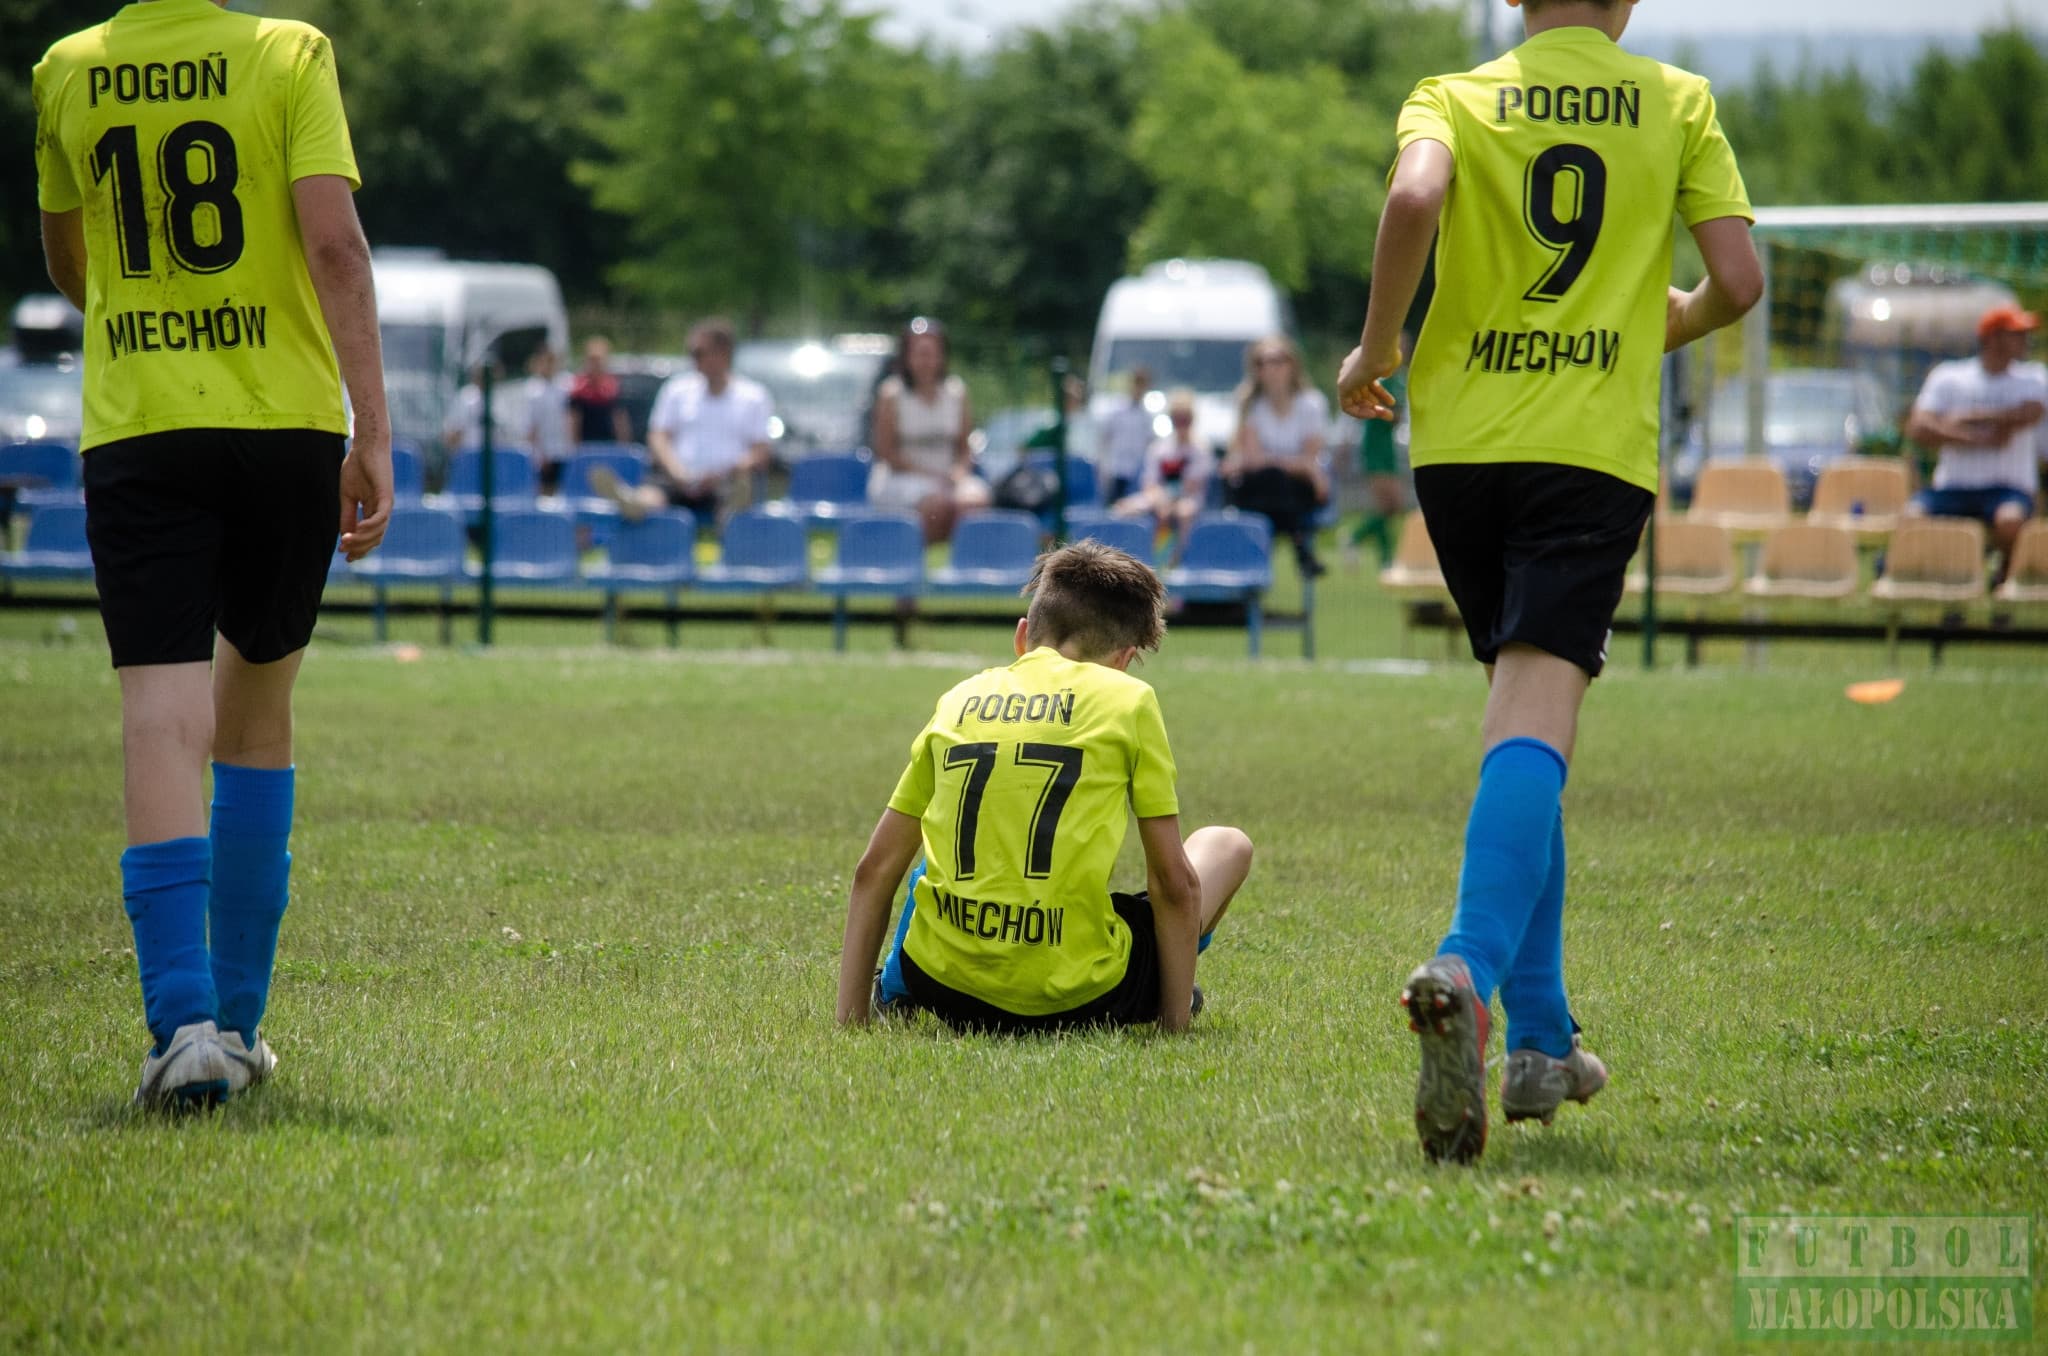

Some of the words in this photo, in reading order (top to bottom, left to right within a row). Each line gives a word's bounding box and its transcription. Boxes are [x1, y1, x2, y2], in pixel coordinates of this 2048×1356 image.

[89, 120, 245, 279] 18
[1522, 143, 1607, 303] 9
[106, 298, 266, 360] MIECHÓW
[943, 742, 1084, 881] 77
[932, 886, 1064, 946] MIECHÓW
